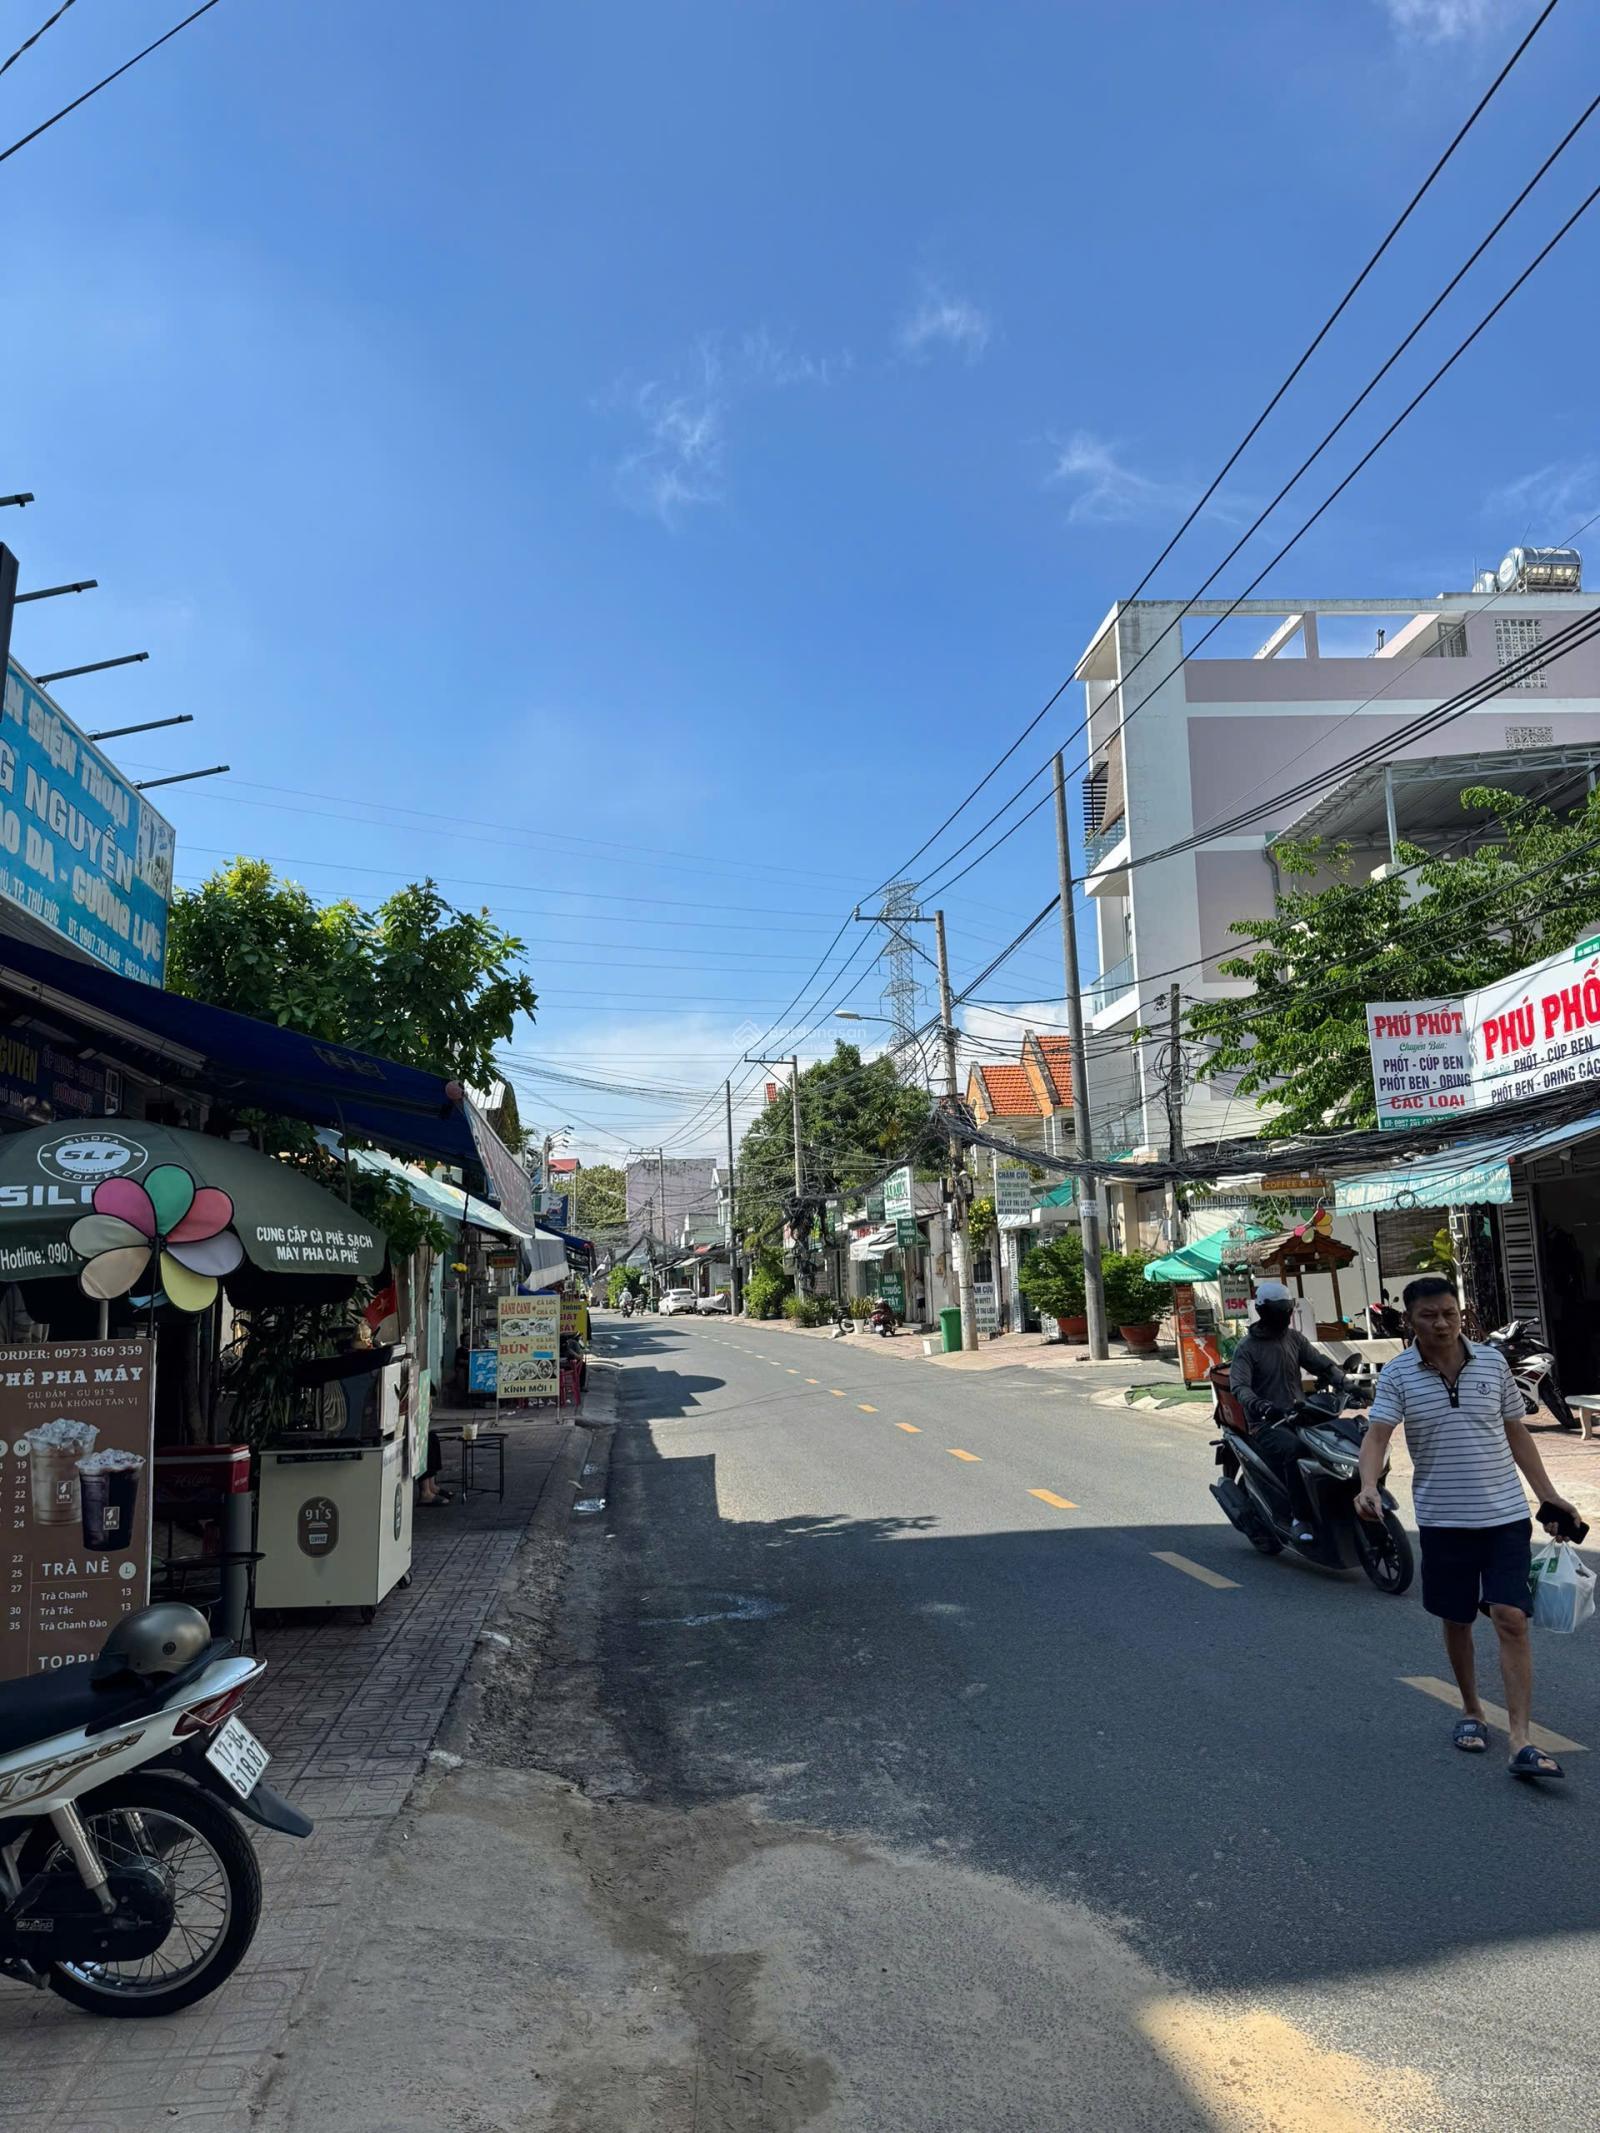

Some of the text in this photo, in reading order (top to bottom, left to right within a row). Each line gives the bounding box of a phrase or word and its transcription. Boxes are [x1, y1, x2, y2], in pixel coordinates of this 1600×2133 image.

[25, 764, 134, 895] NGUYỄN
[26, 824, 55, 883] DA
[73, 865, 131, 941] CƯỜNG
[1373, 1005, 1463, 1037] PHÚ PHỐT
[1481, 996, 1536, 1061] PHÚ
[1546, 1042, 1567, 1063] CÚP
[1571, 1033, 1594, 1056] BEN
[1419, 1054, 1439, 1071] CÚP
[1443, 1056, 1464, 1070] BEN
[1409, 1076, 1430, 1090] BEN
[1439, 1074, 1472, 1089] ORING
[1515, 1077, 1535, 1098] BEN
[1543, 1065, 1576, 1089] ORING
[1428, 1095, 1466, 1110] LOẠI
[61, 1150, 126, 1161] SLF
[61, 1168, 123, 1181] COFFEE
[1264, 1180, 1298, 1190] COFFEE
[1308, 1178, 1324, 1187] TEA
[256, 1225, 373, 1250] CUNG CẤP CÀ PHÊ SẠCH
[0, 1245, 46, 1271] Hotline:
[276, 1242, 360, 1265] MÁY PHA CÀ PHÊ
[1225, 1297, 1248, 1310] 15K
[0, 1345, 143, 1361] ORDER: 0973 369 359
[499, 1341, 529, 1355] BÚN
[41, 1370, 88, 1385] PHA
[94, 1364, 144, 1383] MÁY
[27, 1391, 41, 1400] GU
[77, 1389, 91, 1397] GU
[27, 1401, 47, 1409] TAN
[67, 1398, 102, 1408] KHÔNG
[106, 1397, 125, 1406] TAN
[18, 1444, 26, 1452] M
[17, 1460, 28, 1470] 19
[15, 1475, 27, 1485] 22
[14, 1490, 26, 1499] 22
[13, 1505, 25, 1514] 24
[12, 1520, 25, 1530] 24
[12, 1554, 24, 1563] 22
[11, 1569, 23, 1578] 25
[42, 1559, 78, 1577] TRÀ
[86, 1556, 110, 1574] NÈ
[11, 1584, 22, 1593] 27
[41, 1587, 132, 1601] Trà Chanh 13
[9, 1606, 21, 1615] 30
[40, 1607, 56, 1616] Trà
[121, 1602, 131, 1612] 13
[9, 1622, 21, 1631] 35
[40, 1618, 108, 1631] Trà Chanh Đào
[230, 1740, 267, 1794] 618.87
